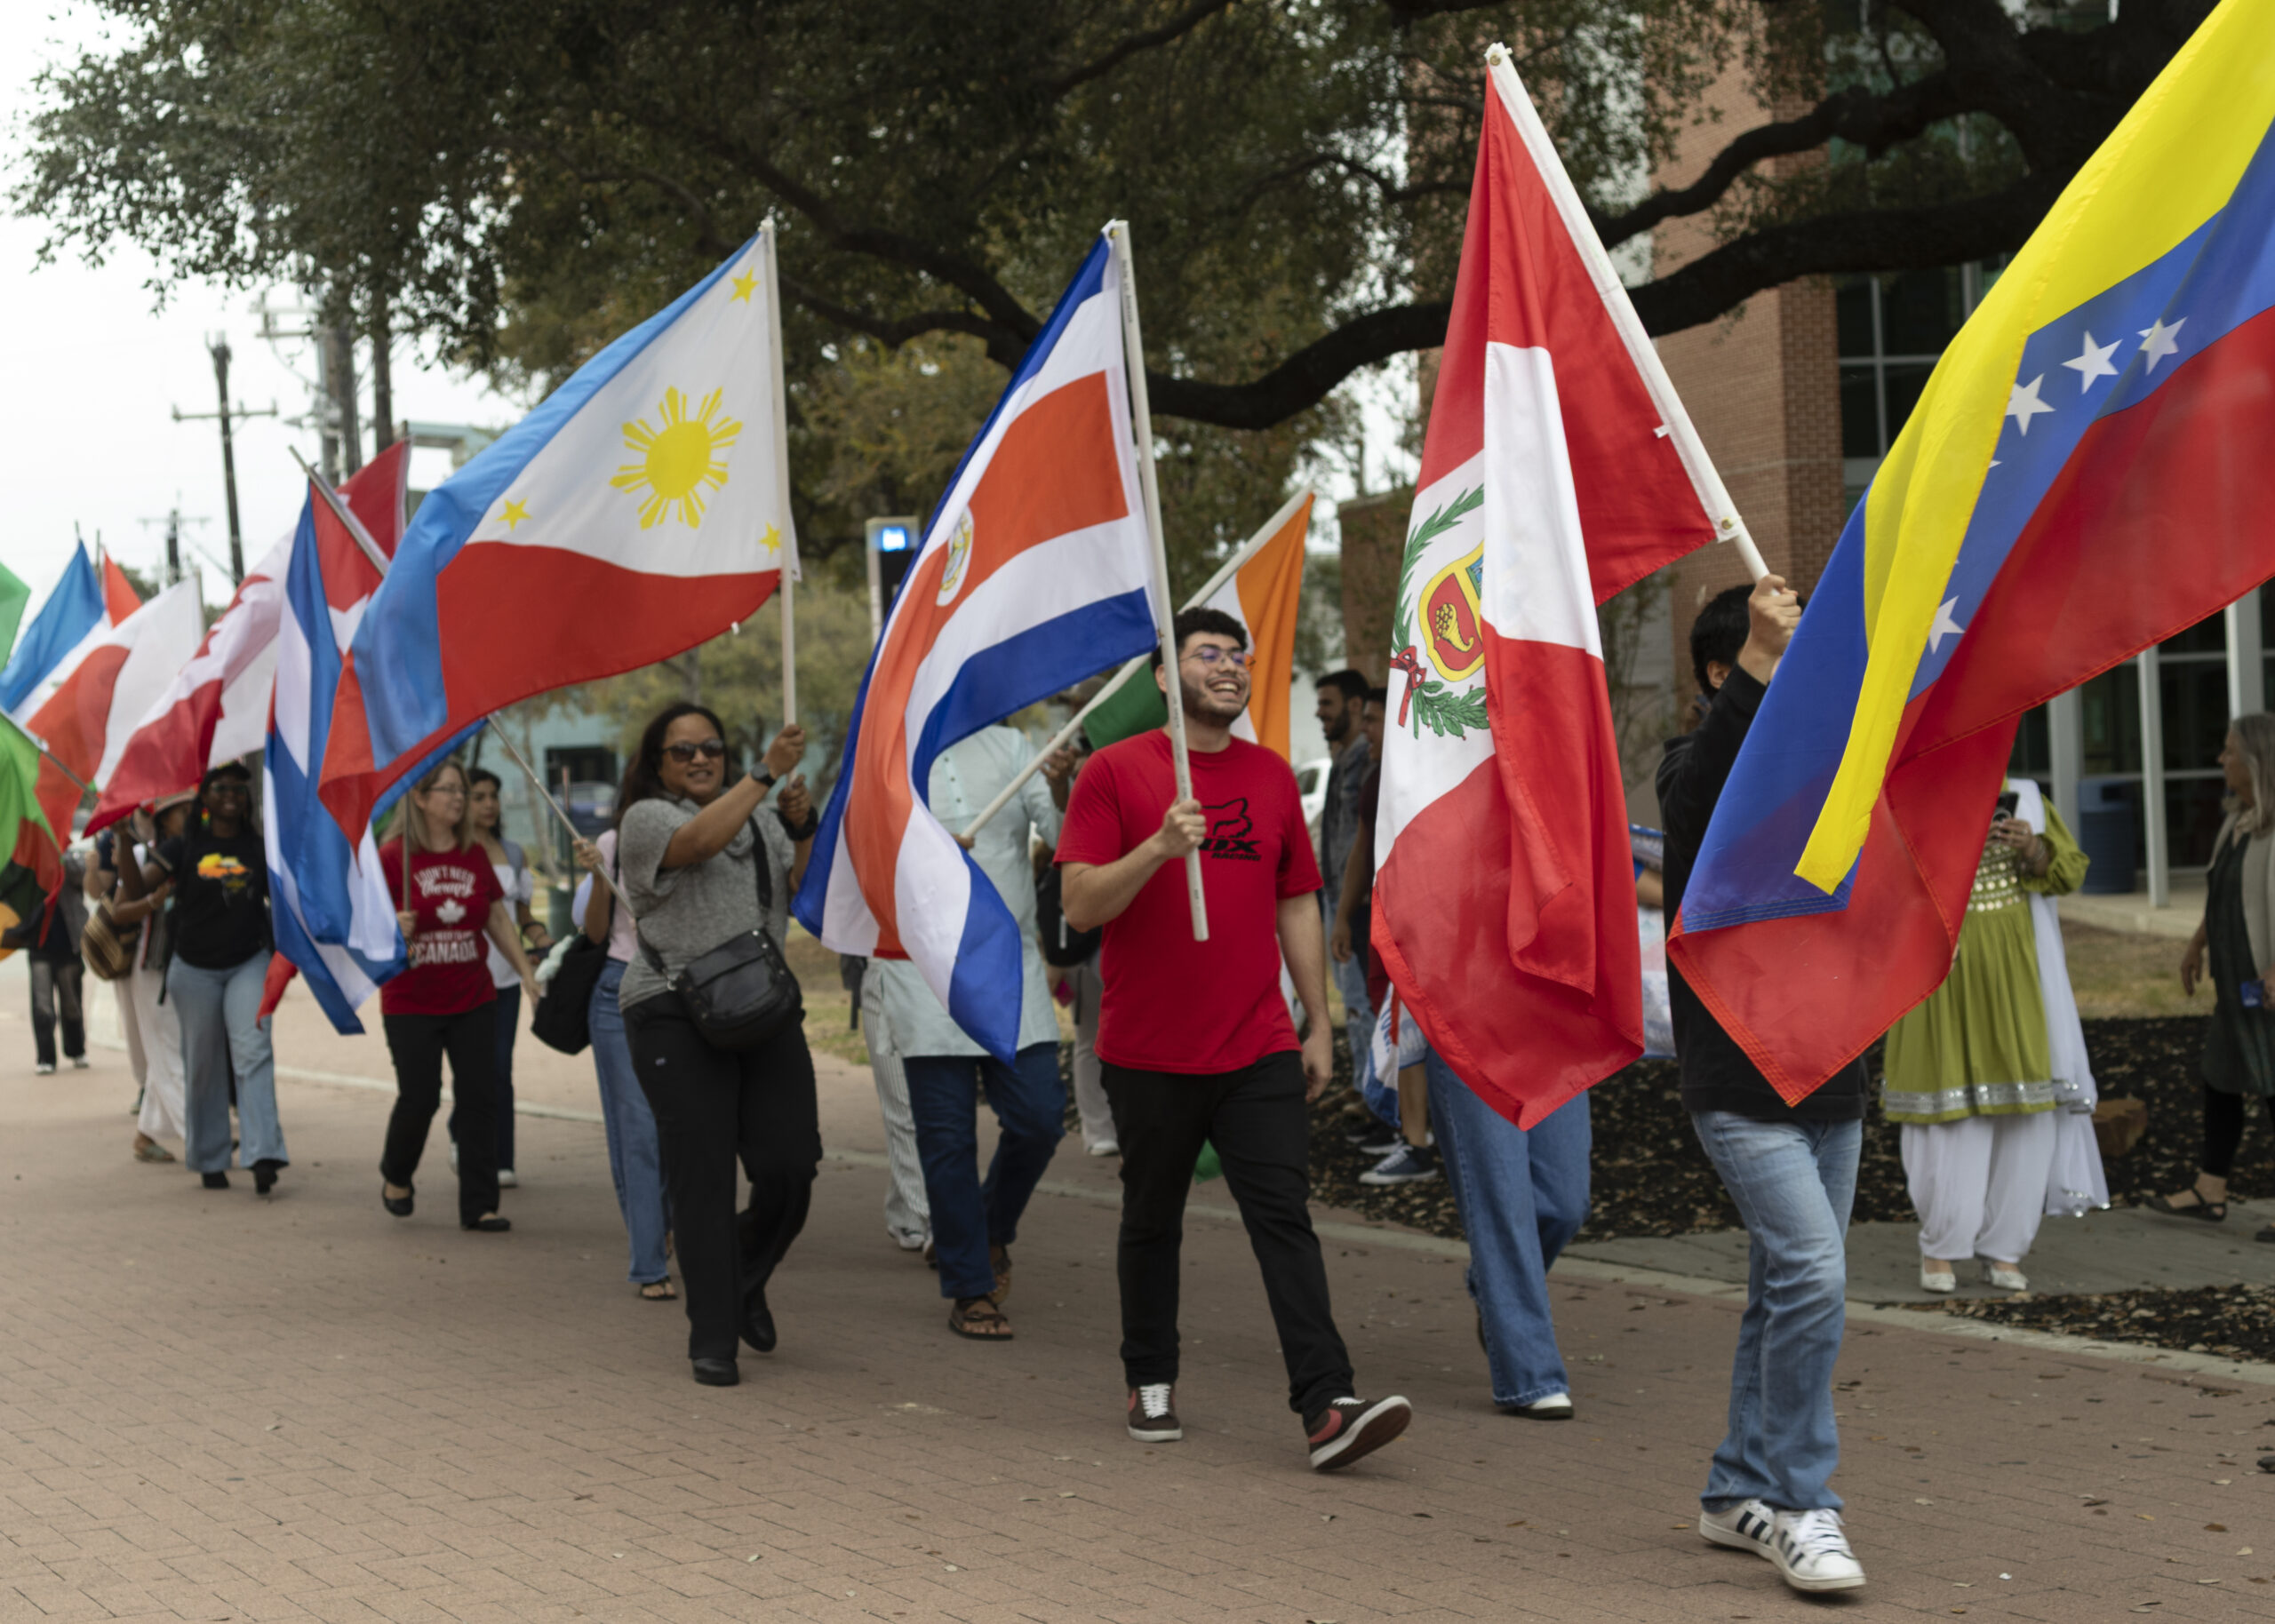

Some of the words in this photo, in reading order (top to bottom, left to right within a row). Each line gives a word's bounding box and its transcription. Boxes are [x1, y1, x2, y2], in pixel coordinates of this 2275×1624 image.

[1199, 839, 1261, 854] OX
[419, 865, 448, 881] DON'T
[450, 866, 476, 883] NEED
[415, 938, 478, 964] CANADA
